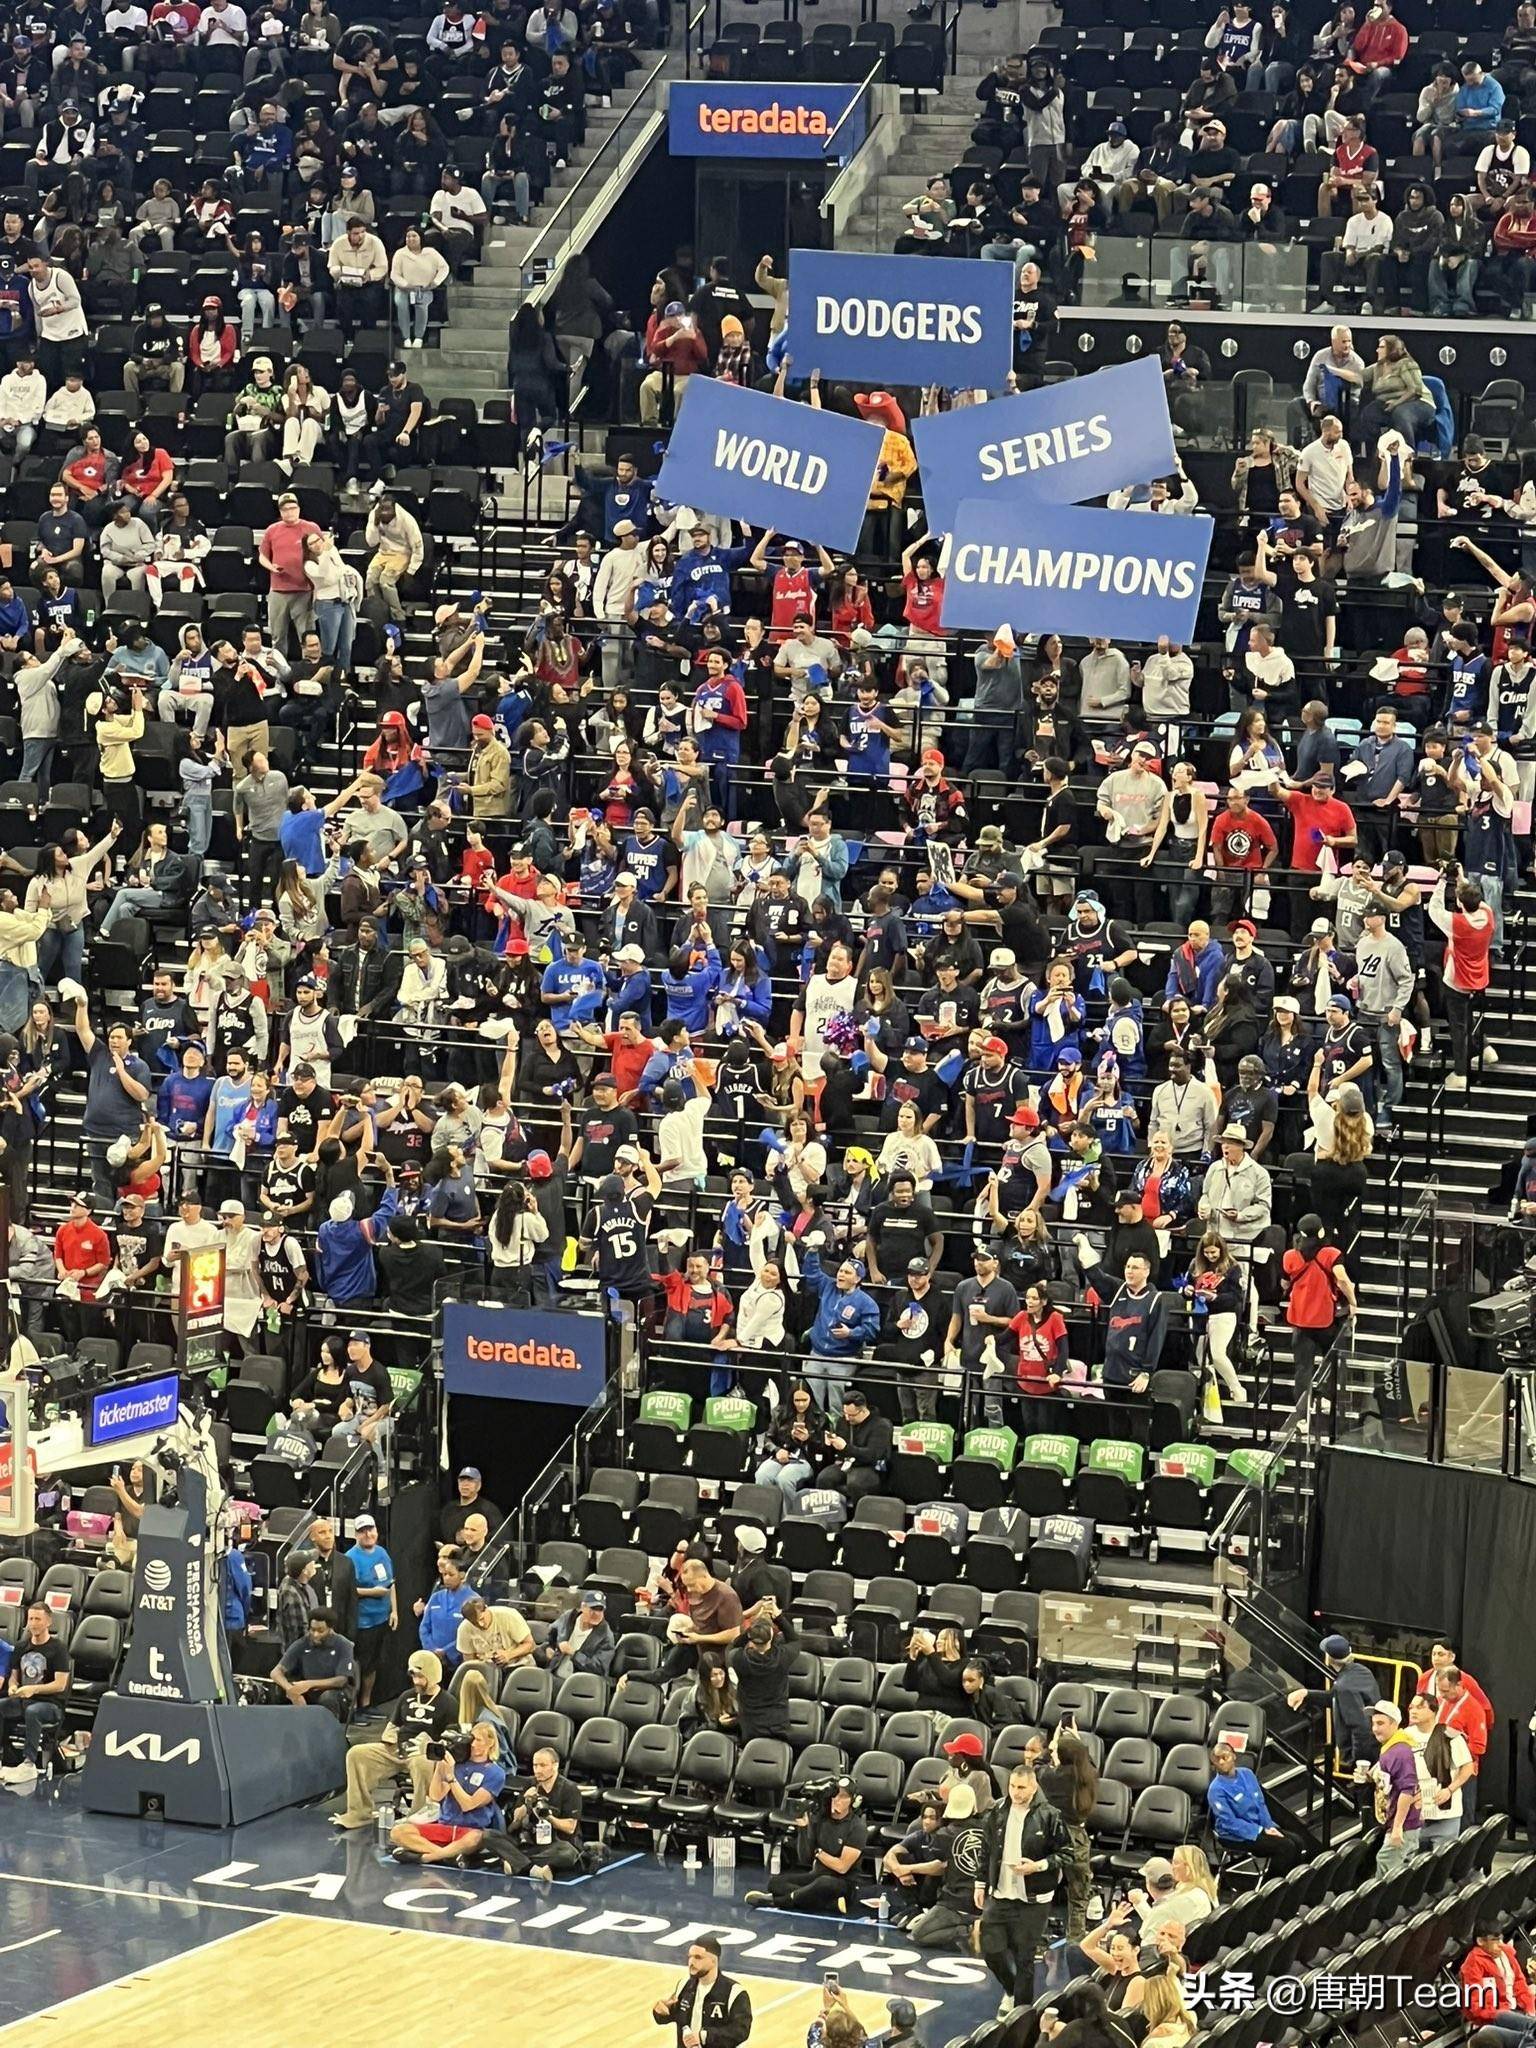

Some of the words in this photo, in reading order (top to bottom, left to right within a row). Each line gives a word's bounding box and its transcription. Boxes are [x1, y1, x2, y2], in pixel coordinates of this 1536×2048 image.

[700, 103, 833, 135] teradata.
[816, 296, 982, 344] DODGERS
[979, 415, 1112, 481] SERIES
[714, 429, 828, 495] WORLD
[955, 544, 1196, 599] CHAMPIONS
[1453, 683, 1467, 698] 23
[859, 734, 869, 751] 2
[1481, 815, 1491, 831] 3
[633, 865, 650, 880] 34
[628, 921, 638, 932] C
[872, 939, 880, 954] 1
[1246, 974, 1257, 986] C
[145, 1017, 175, 1030] Clips
[1002, 1008, 1013, 1023] 2
[816, 1018, 825, 1034] 2
[223, 1031, 232, 1046] 2
[1331, 1060, 1346, 1075] 19
[733, 1094, 745, 1119] 1
[994, 1103, 1003, 1119] 7
[406, 1134, 424, 1148] 32
[608, 1231, 638, 1260] 15
[272, 1275, 284, 1291] 14
[703, 1308, 712, 1324] 3
[466, 1335, 582, 1370] teradata.
[1129, 1336, 1138, 1351] 1
[99, 1394, 173, 1428] ticketmaster
[646, 1395, 684, 1413] PRIDE
[712, 1397, 750, 1415] PRIDE
[273, 1435, 309, 1462] PRIDE
[970, 1435, 1008, 1454] PRIDE
[1030, 1439, 1071, 1459] PRIDE
[1096, 1444, 1135, 1463] PRIDE
[801, 1491, 841, 1510] PRIDE
[1044, 1518, 1085, 1540] PRIDE
[139, 1594, 176, 1612] AT&T
[150, 1647, 172, 1682] t.
[128, 1681, 183, 1698] teradata.
[193, 1861, 347, 1901] LA
[383, 1888, 987, 1986] CLIPPERS
[709, 2005, 722, 2019] A
